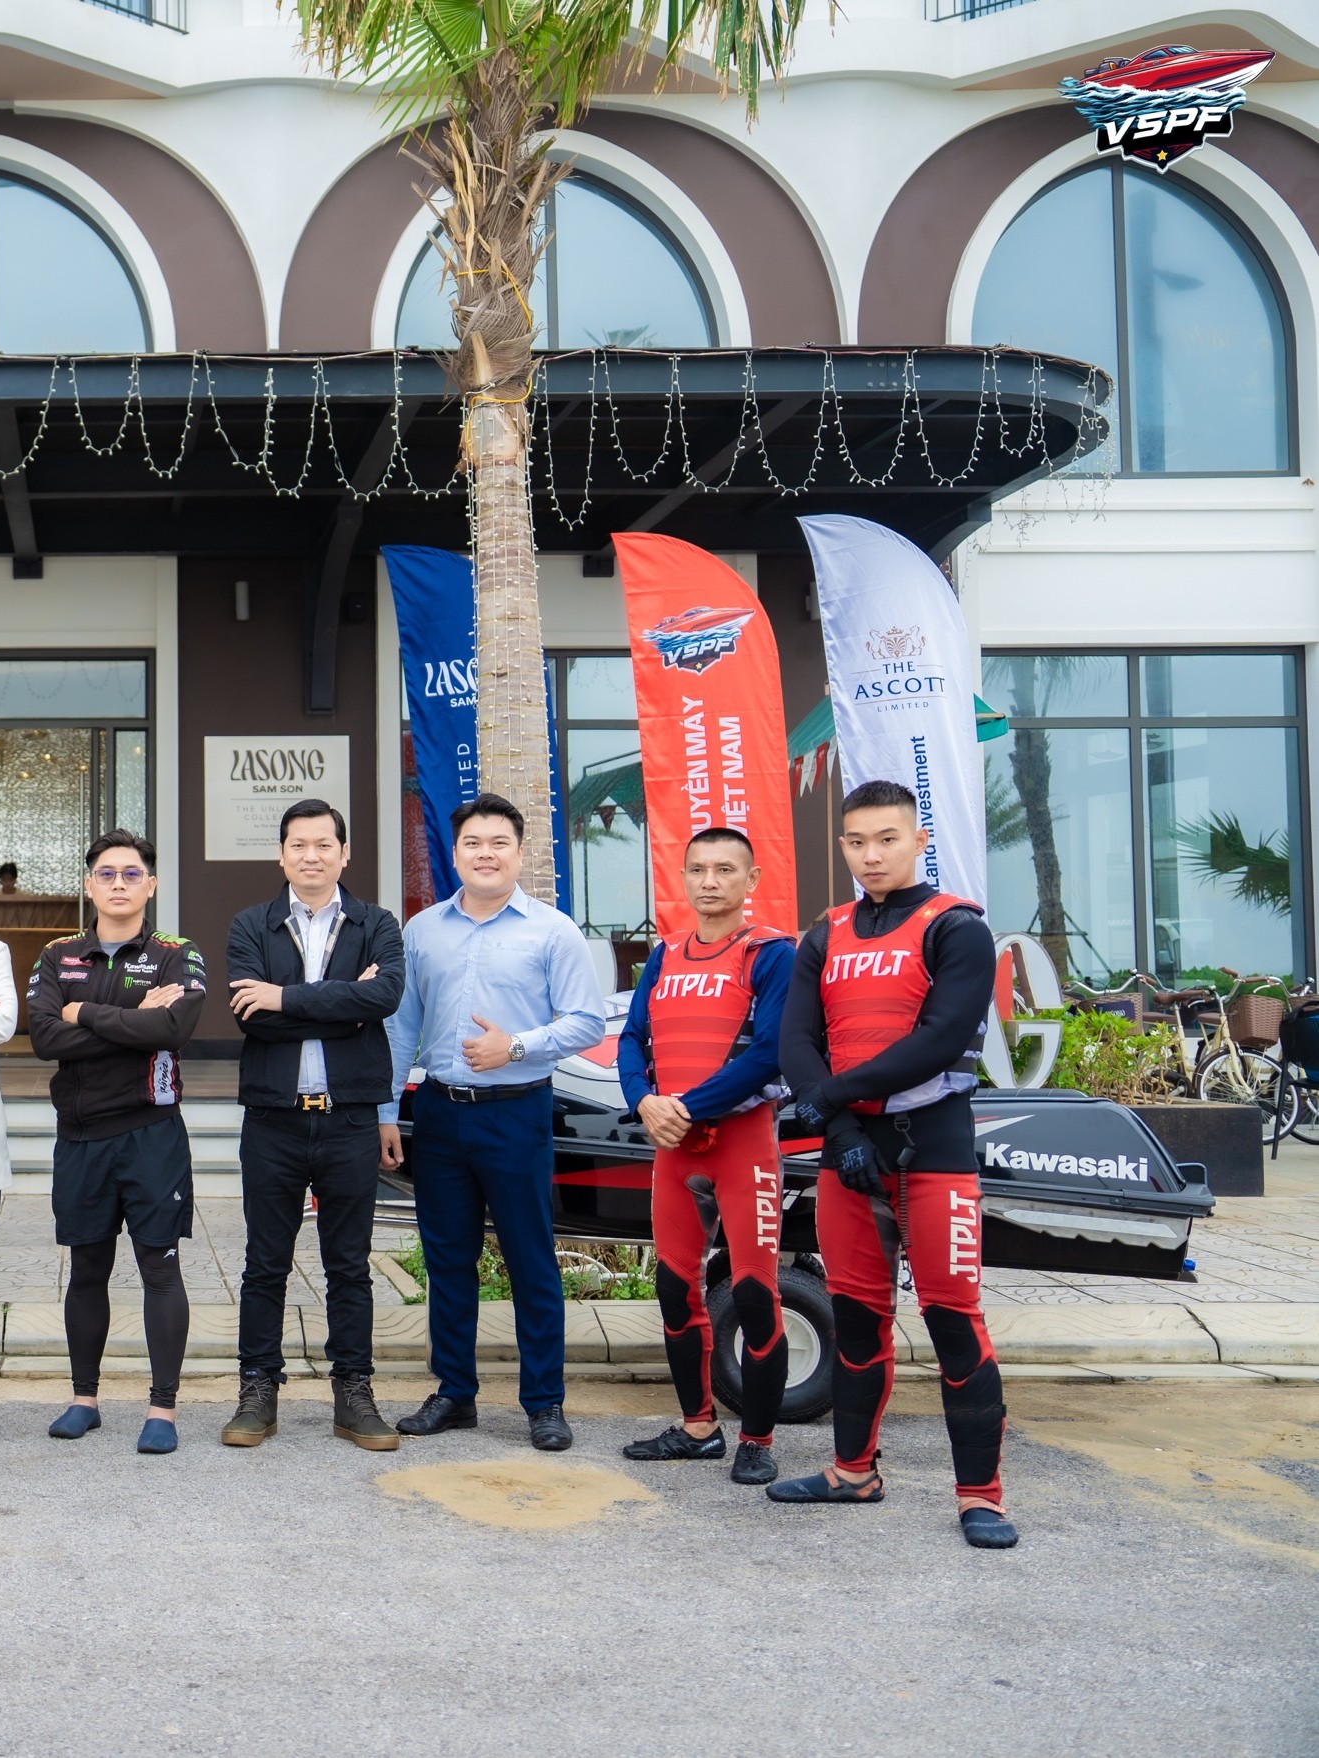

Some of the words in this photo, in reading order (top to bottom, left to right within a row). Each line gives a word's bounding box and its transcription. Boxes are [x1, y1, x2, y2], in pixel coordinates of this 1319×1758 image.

[667, 638, 732, 665] VSPF
[882, 661, 916, 674] THE
[854, 676, 945, 700] ASCOTT
[877, 701, 930, 713] LIMITED
[680, 695, 708, 755] MÁY
[230, 748, 325, 781] LASONG
[718, 716, 745, 779] NAM
[252, 785, 277, 793] SAM
[280, 785, 303, 793] SON
[457, 743, 475, 804] ITED
[681, 758, 712, 838] UYỀN
[826, 950, 912, 985] JTPLT
[655, 973, 731, 1000] JTPLT
[985, 1142, 1148, 1182] Kawasaki
[754, 1165, 777, 1254] JTPLT
[949, 1190, 979, 1283] JTPLT
